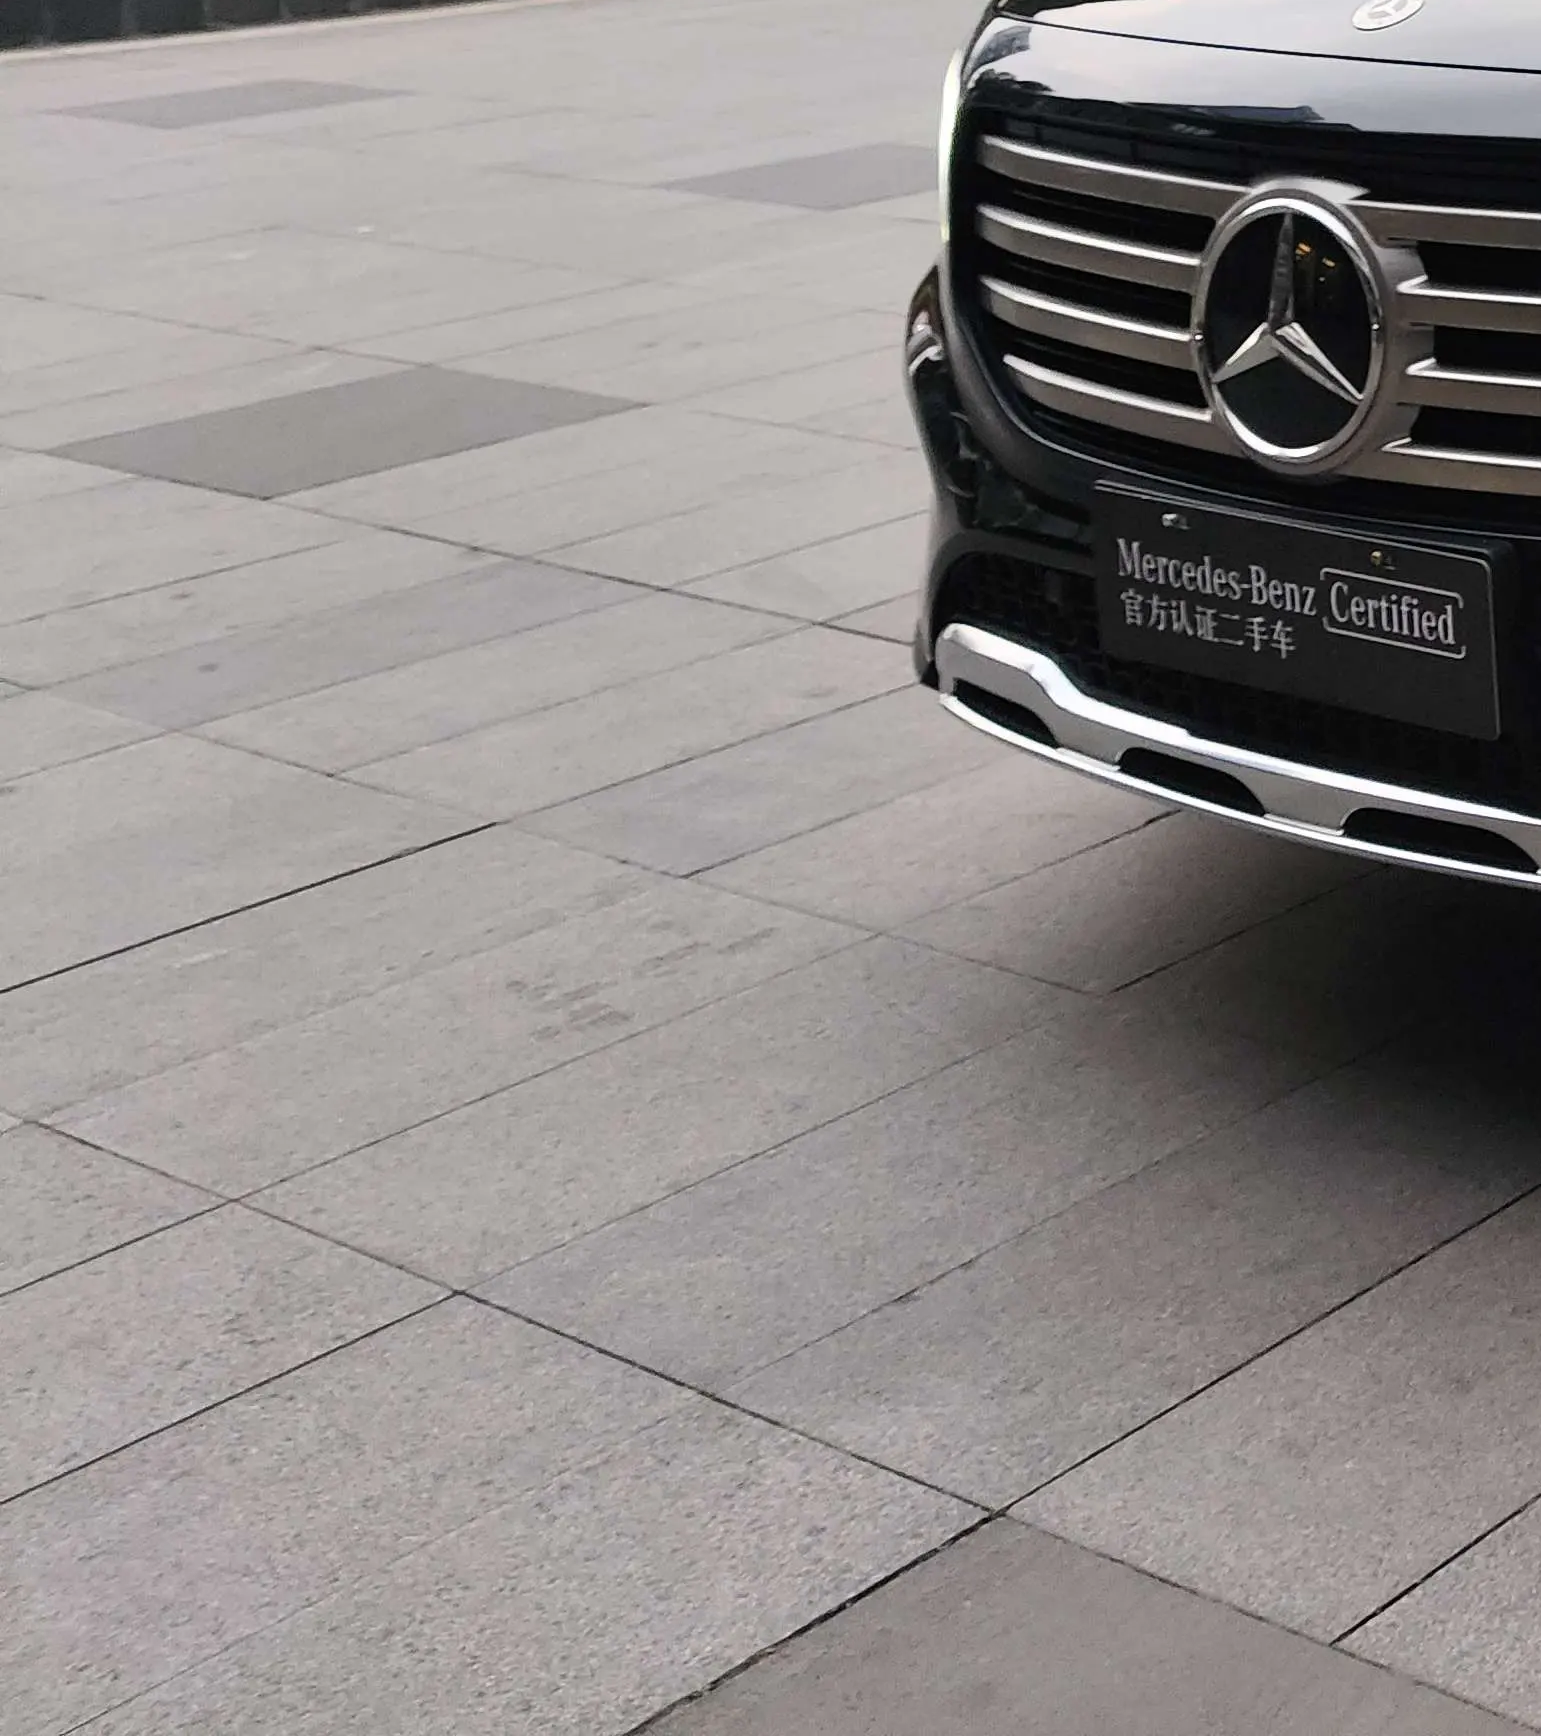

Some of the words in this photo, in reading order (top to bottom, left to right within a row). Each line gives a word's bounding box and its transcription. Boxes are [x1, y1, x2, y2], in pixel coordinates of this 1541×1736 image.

[1116, 537, 1317, 617] Mercedes-Benz
[1329, 579, 1457, 646] Certified
[1119, 587, 1298, 659] 官方认证二手车
